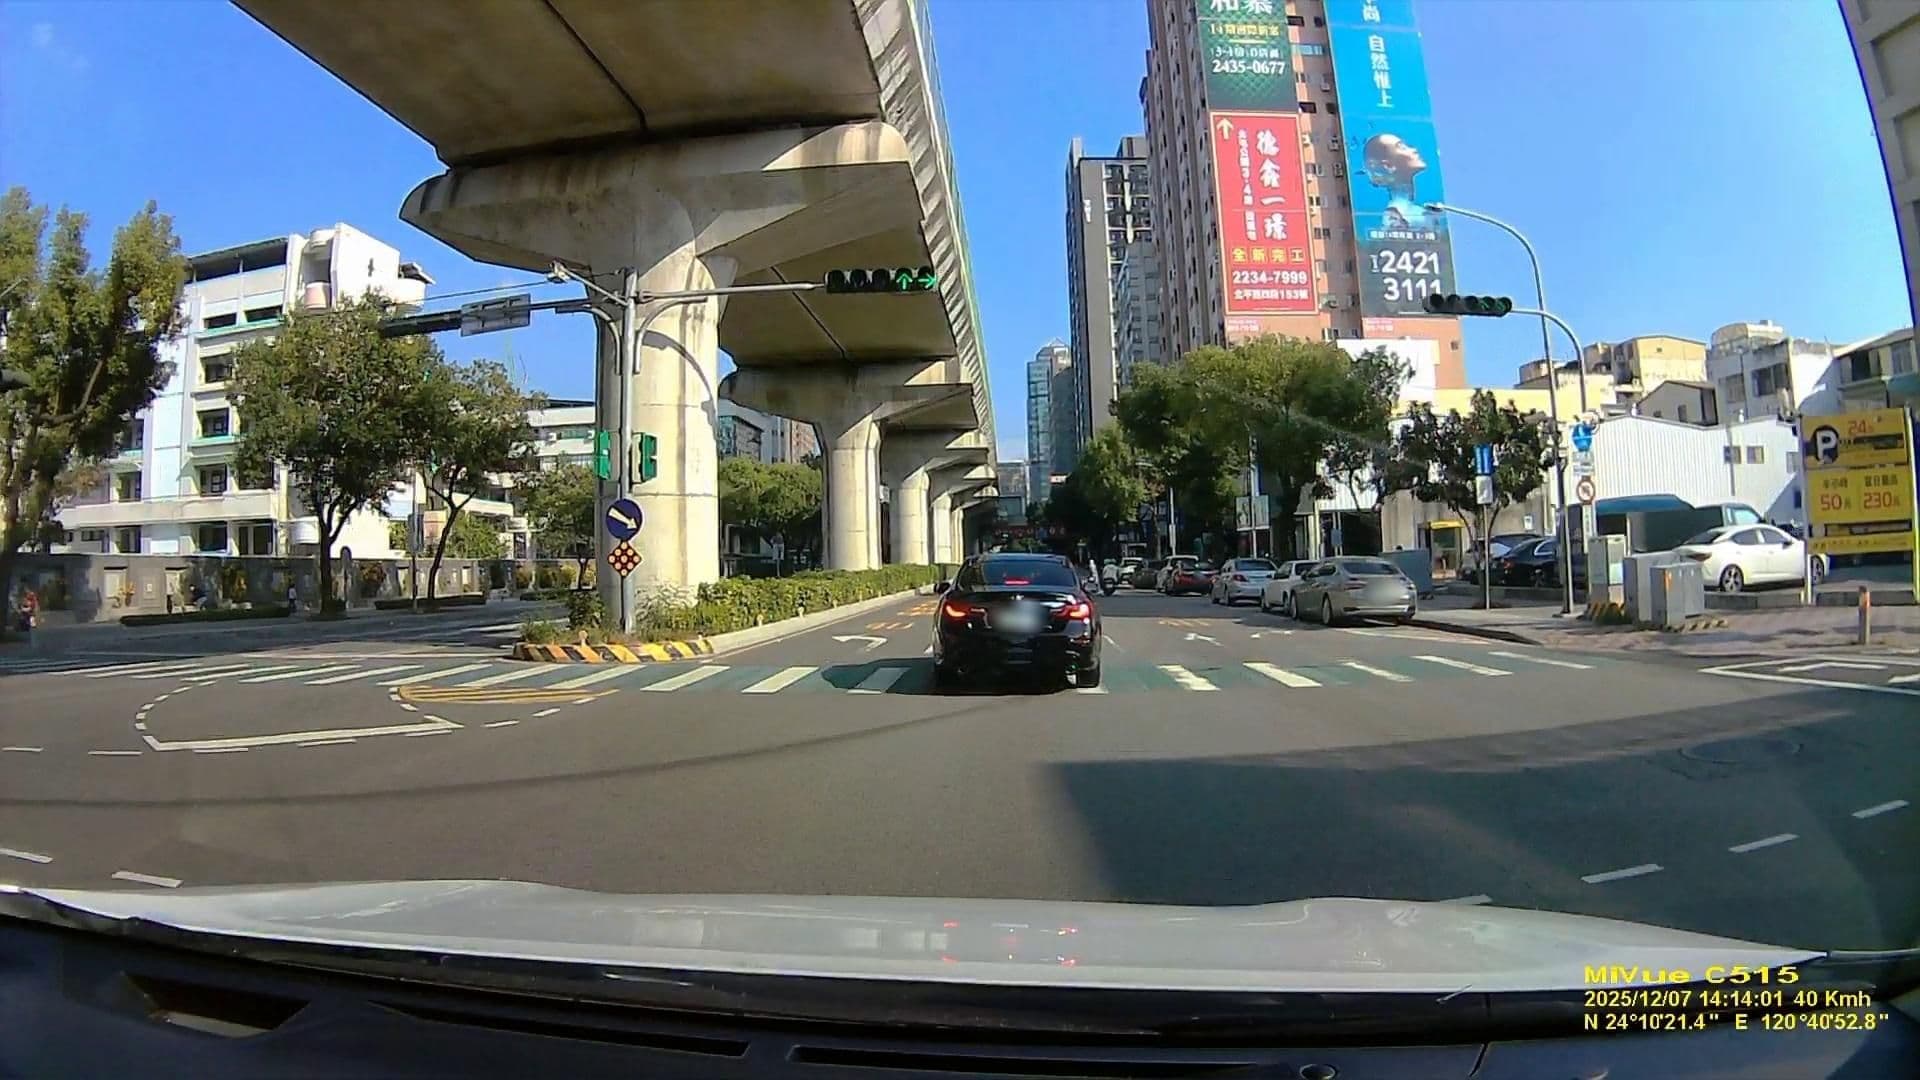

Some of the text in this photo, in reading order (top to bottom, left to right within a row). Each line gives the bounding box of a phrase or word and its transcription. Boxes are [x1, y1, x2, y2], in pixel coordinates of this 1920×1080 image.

[1212, 59, 1286, 75] 2435-0677
[1379, 249, 1440, 275] 2421
[1232, 270, 1309, 285] 2234-7999
[1383, 277, 1441, 301] 3111
[1815, 429, 1839, 464] P
